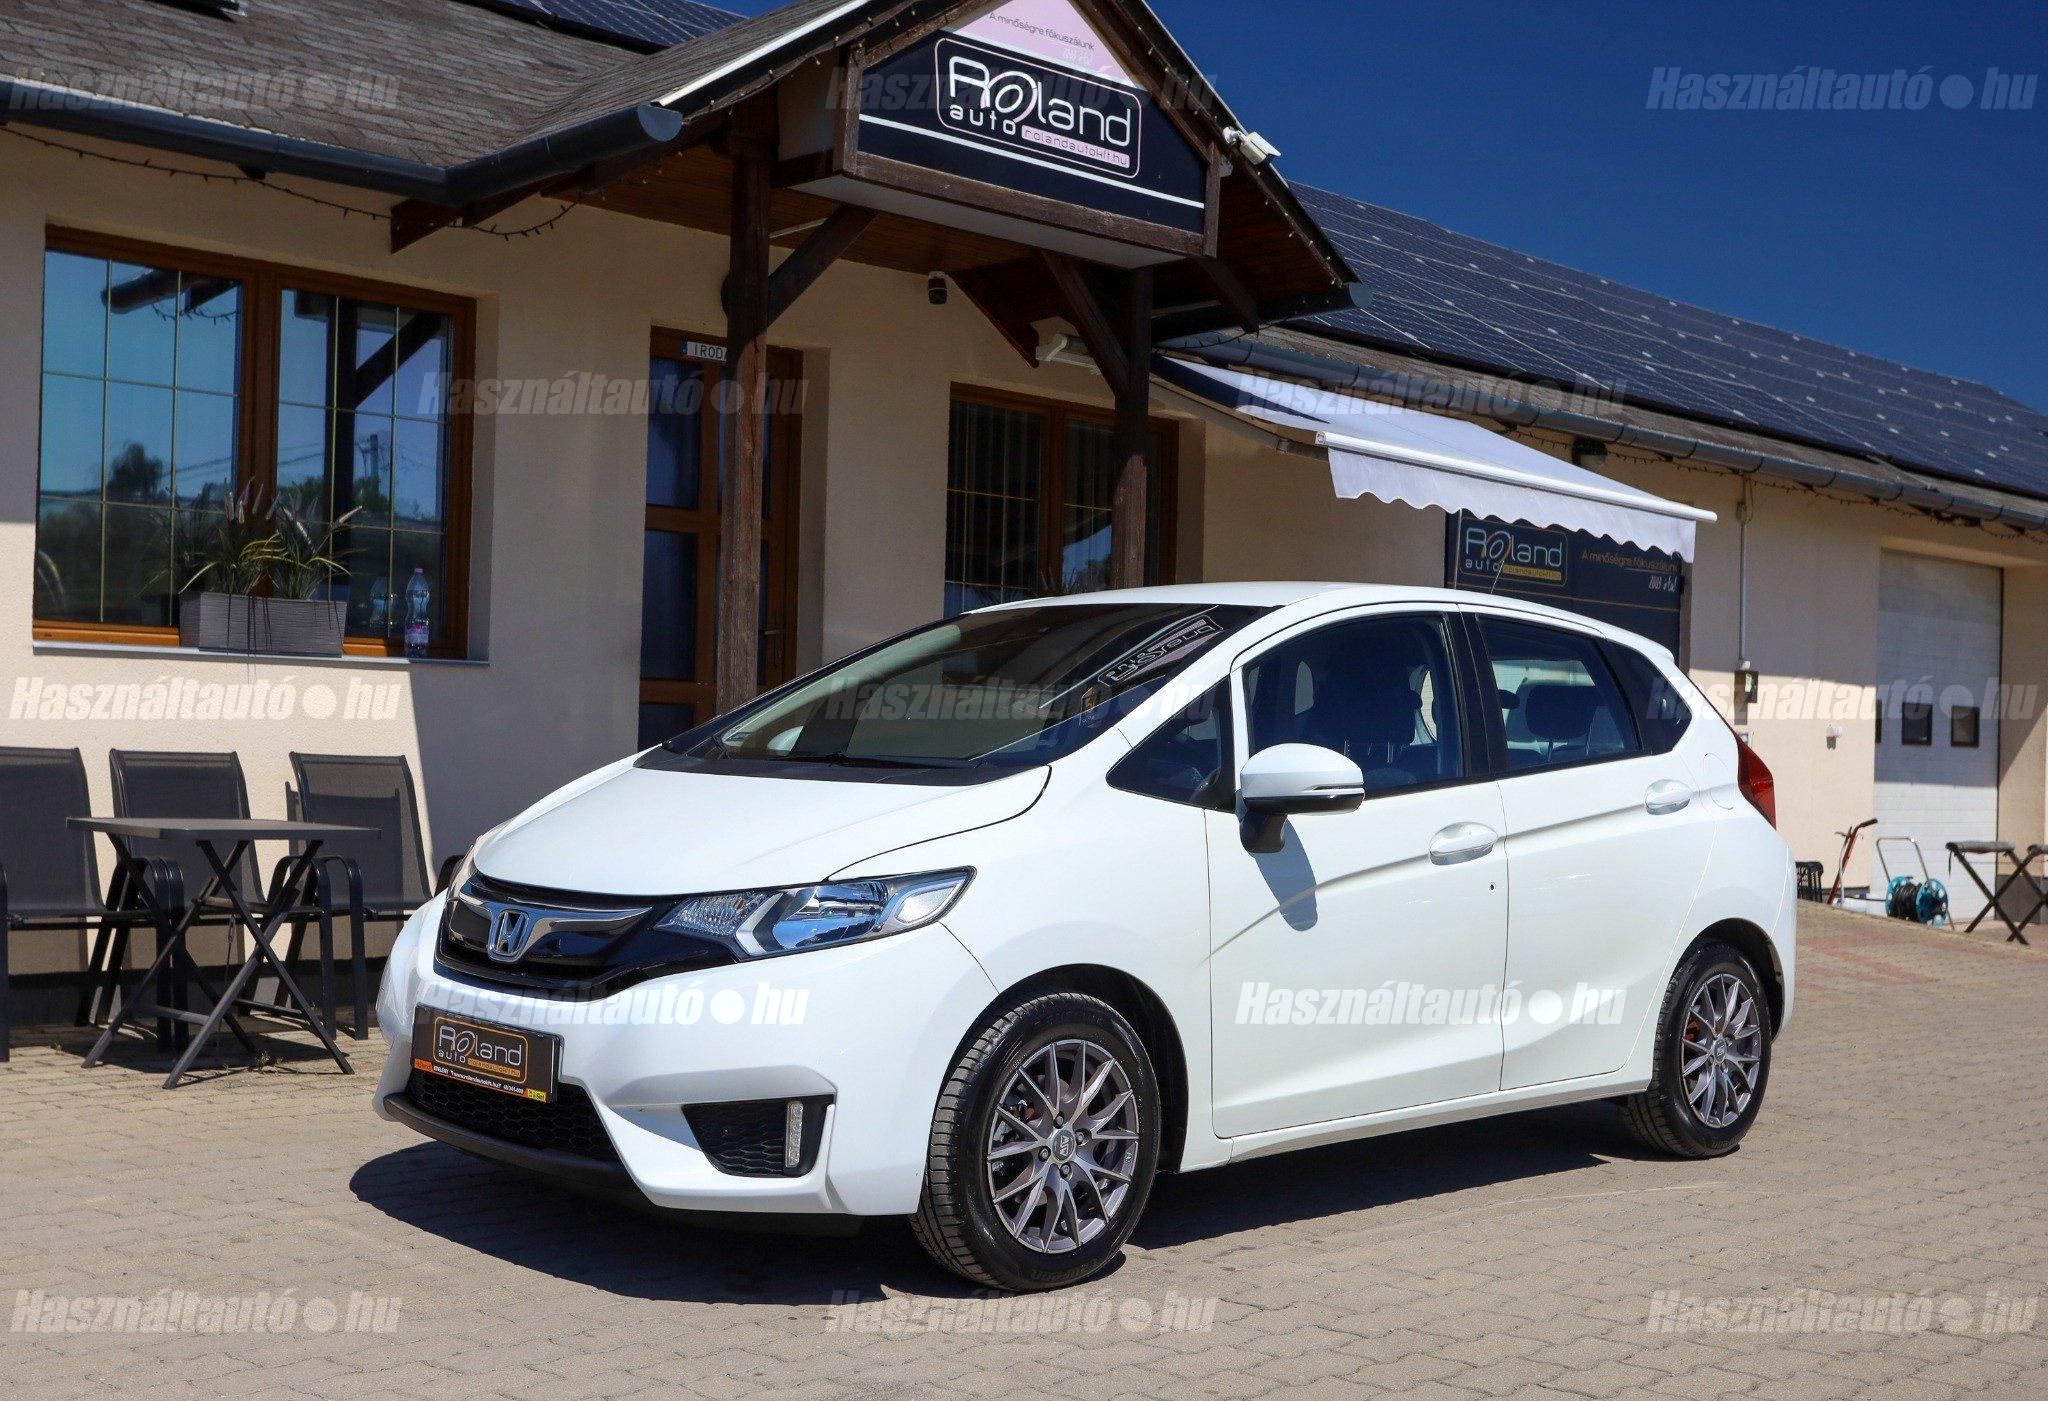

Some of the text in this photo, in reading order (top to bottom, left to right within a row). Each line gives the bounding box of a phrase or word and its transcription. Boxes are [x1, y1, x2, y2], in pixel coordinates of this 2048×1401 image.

[949, 55, 1132, 147] Roland
[949, 104, 1017, 136] auto
[1024, 128, 1129, 167] rolandautokft.hu
[694, 344, 727, 361] IROD
[1465, 527, 1563, 568] Roland
[1465, 558, 1500, 573] auto
[438, 1024, 523, 1067] Roland
[438, 1049, 467, 1064] auto
